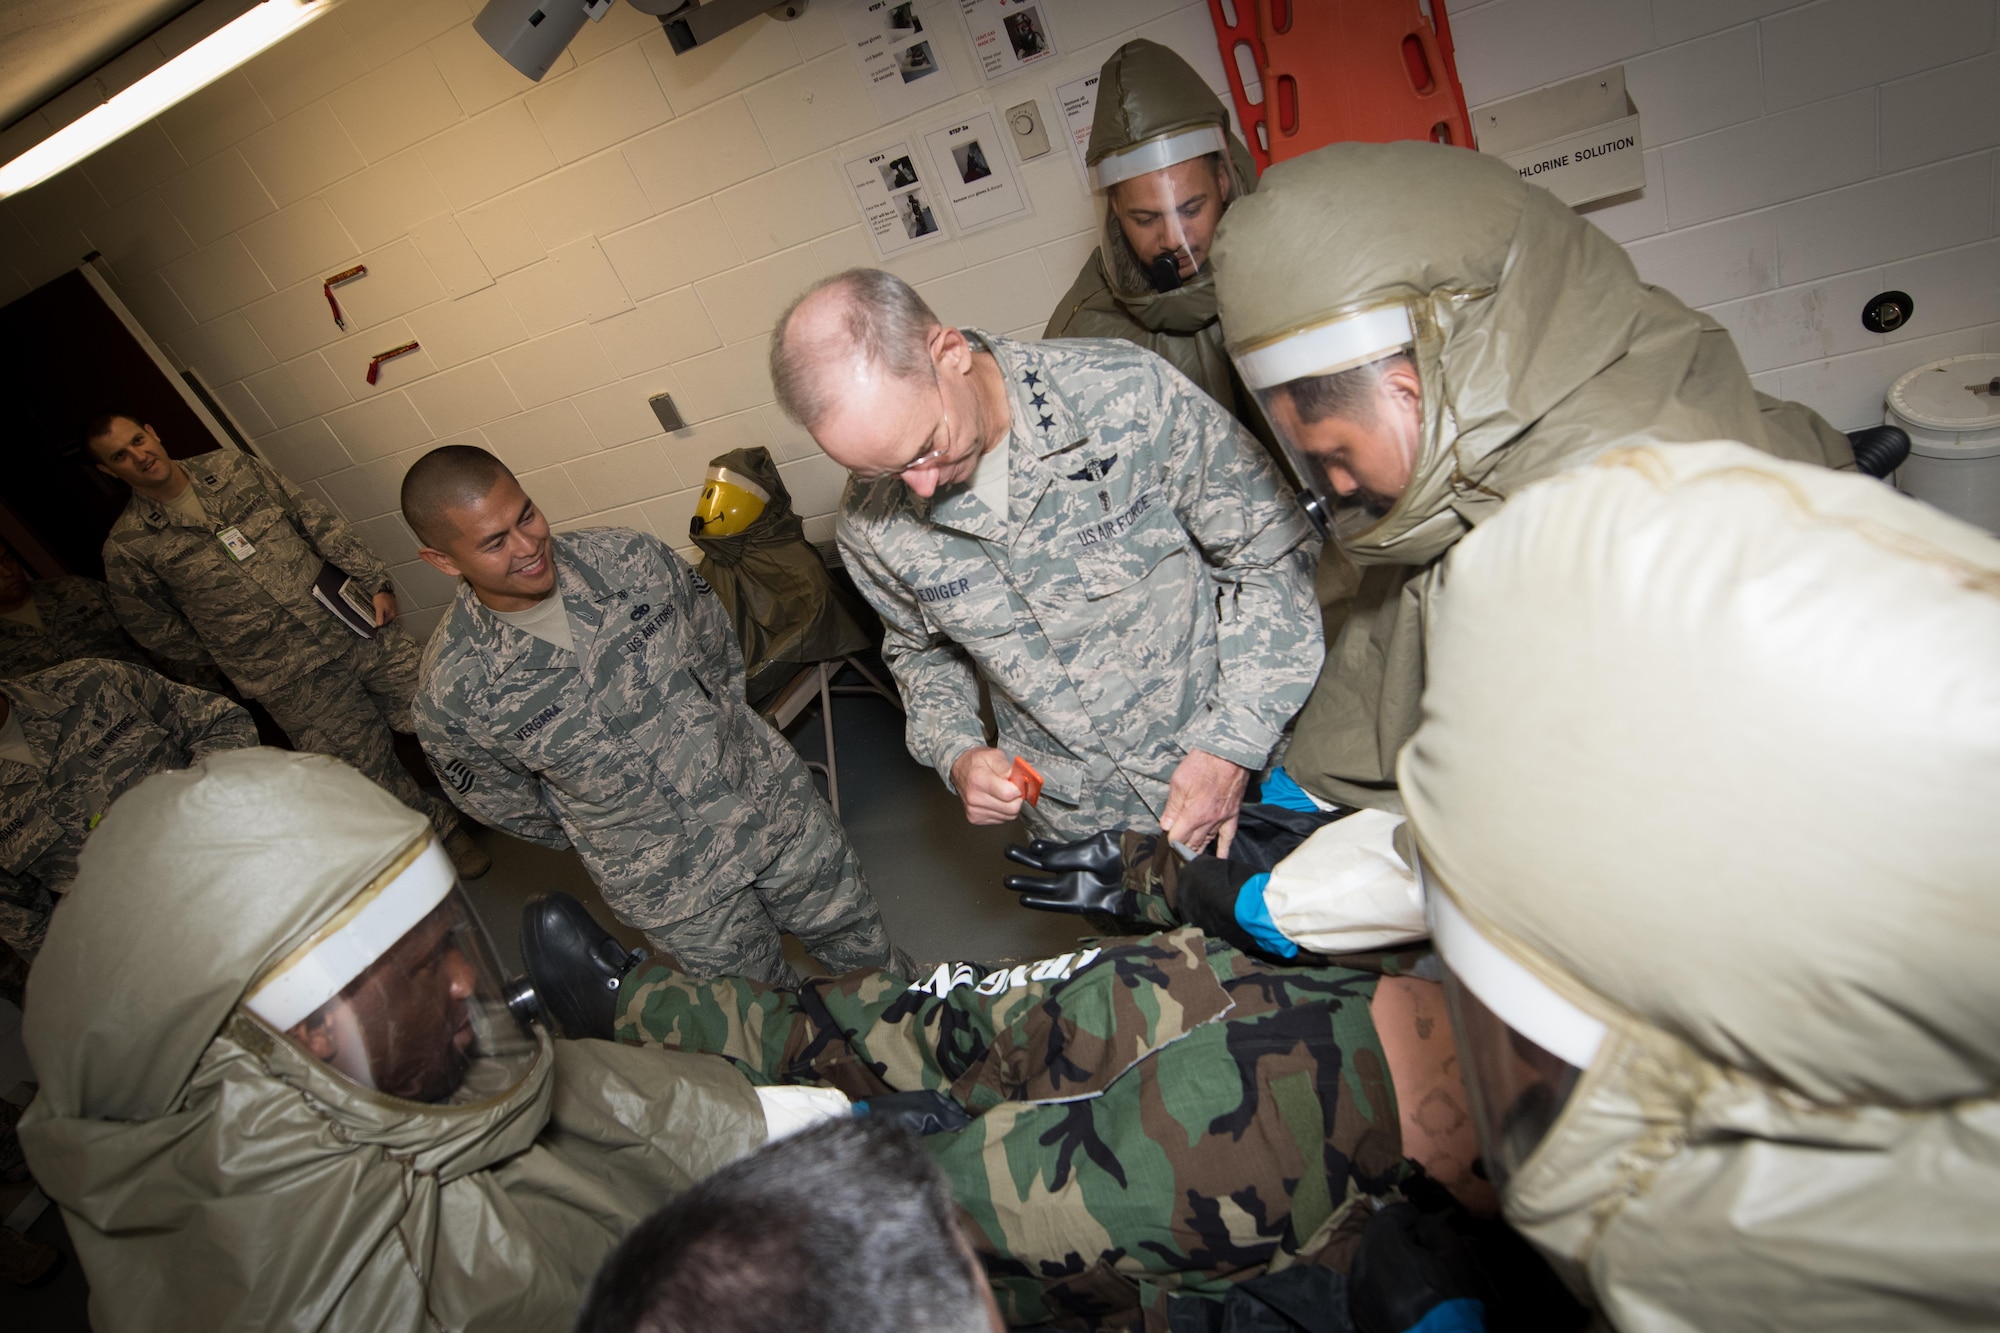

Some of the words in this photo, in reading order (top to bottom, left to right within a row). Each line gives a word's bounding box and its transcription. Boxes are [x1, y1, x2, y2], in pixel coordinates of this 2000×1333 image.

[868, 2, 881, 11] STEP
[975, 33, 986, 41] LEAVE
[1084, 77, 1098, 86] STEP
[949, 127, 961, 135] STEP
[1515, 154, 1570, 178] HLORINE
[1575, 136, 1634, 162] SOLUTION
[1097, 522, 1117, 543] AIR
[1117, 494, 1151, 533] FORCE
[917, 577, 970, 602] EDIGER
[643, 620, 658, 640] AIR
[655, 602, 676, 628] FORCE
[102, 731, 119, 746] AIR
[113, 713, 137, 734] FORCE
[513, 704, 565, 742] VERGARA
